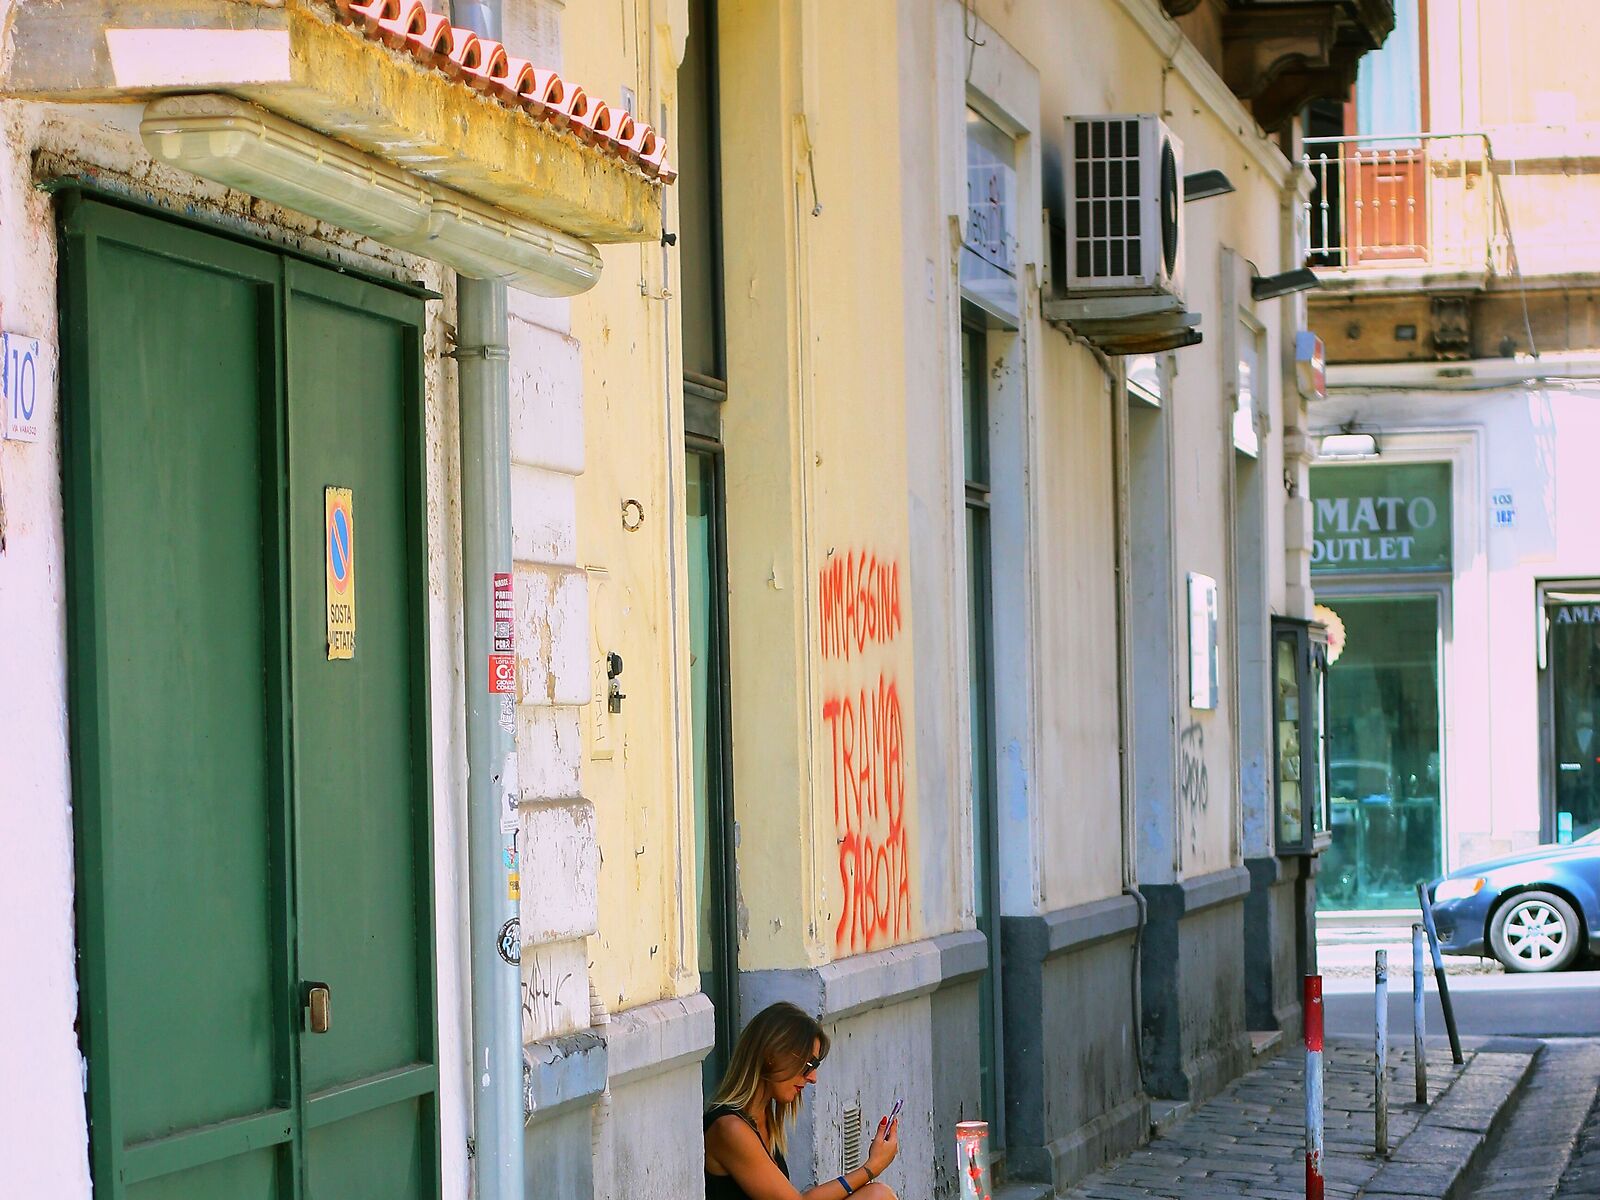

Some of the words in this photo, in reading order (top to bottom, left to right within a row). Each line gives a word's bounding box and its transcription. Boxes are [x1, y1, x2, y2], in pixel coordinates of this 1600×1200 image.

[330, 604, 352, 624] SOSTA
[819, 549, 902, 661] IMMAGGINA
[836, 830, 911, 951] SABOTA
